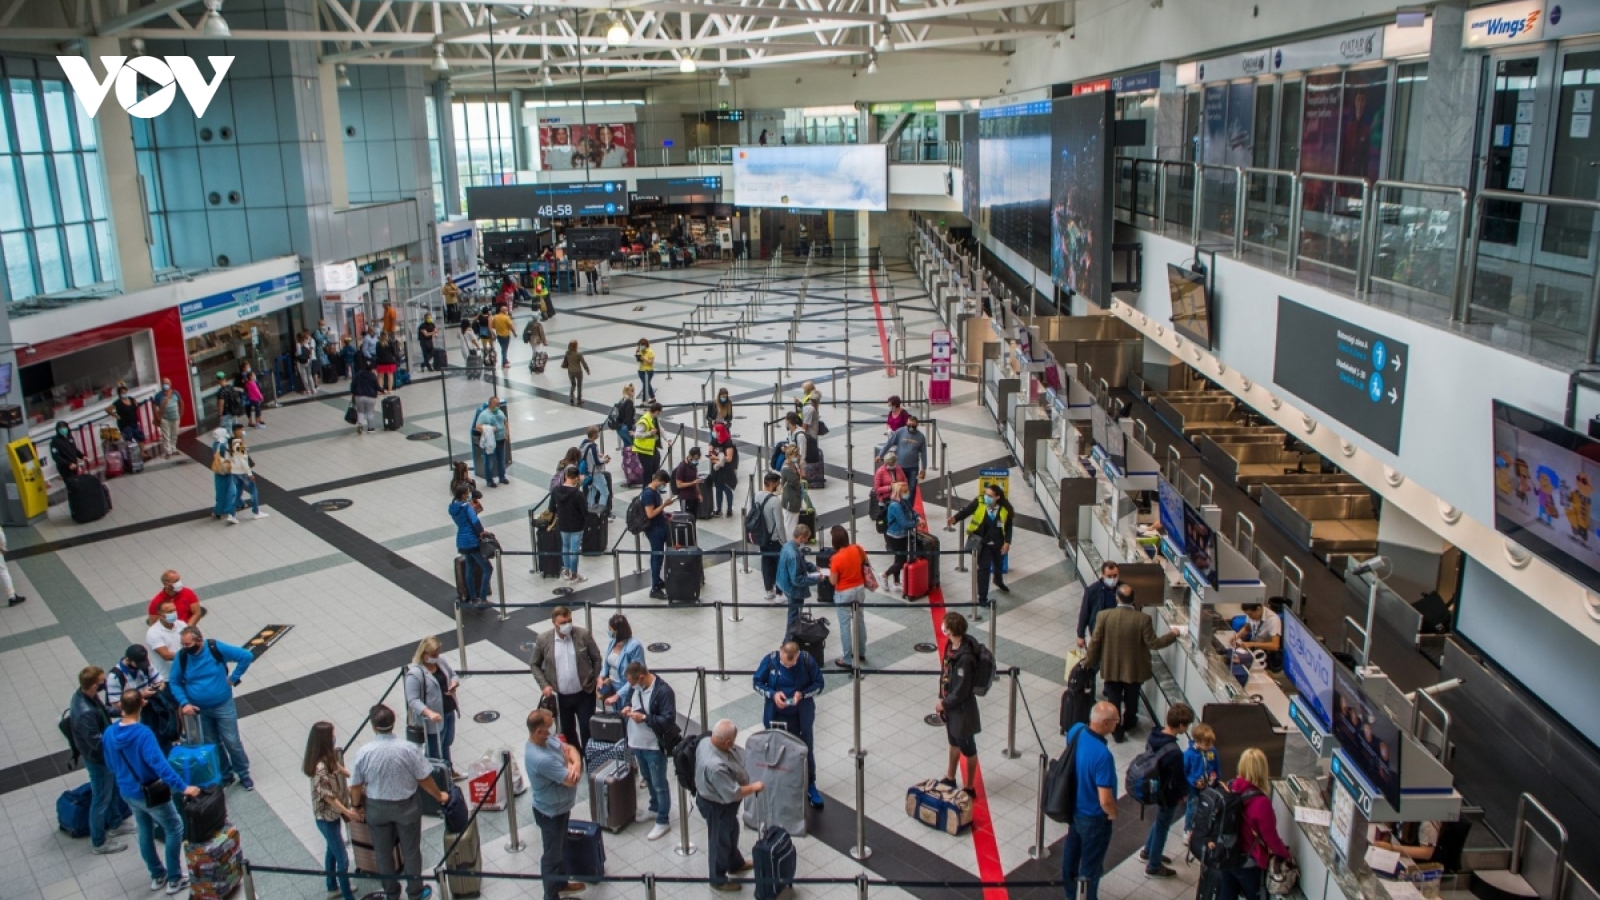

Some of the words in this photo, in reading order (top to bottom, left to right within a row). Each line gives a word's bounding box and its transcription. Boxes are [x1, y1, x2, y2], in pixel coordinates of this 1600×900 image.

[1340, 38, 1365, 55] QATAR
[537, 203, 573, 217] 48-58
[1288, 624, 1329, 687] Belavia
[1310, 730, 1321, 750] 69
[1358, 787, 1371, 813] 70
